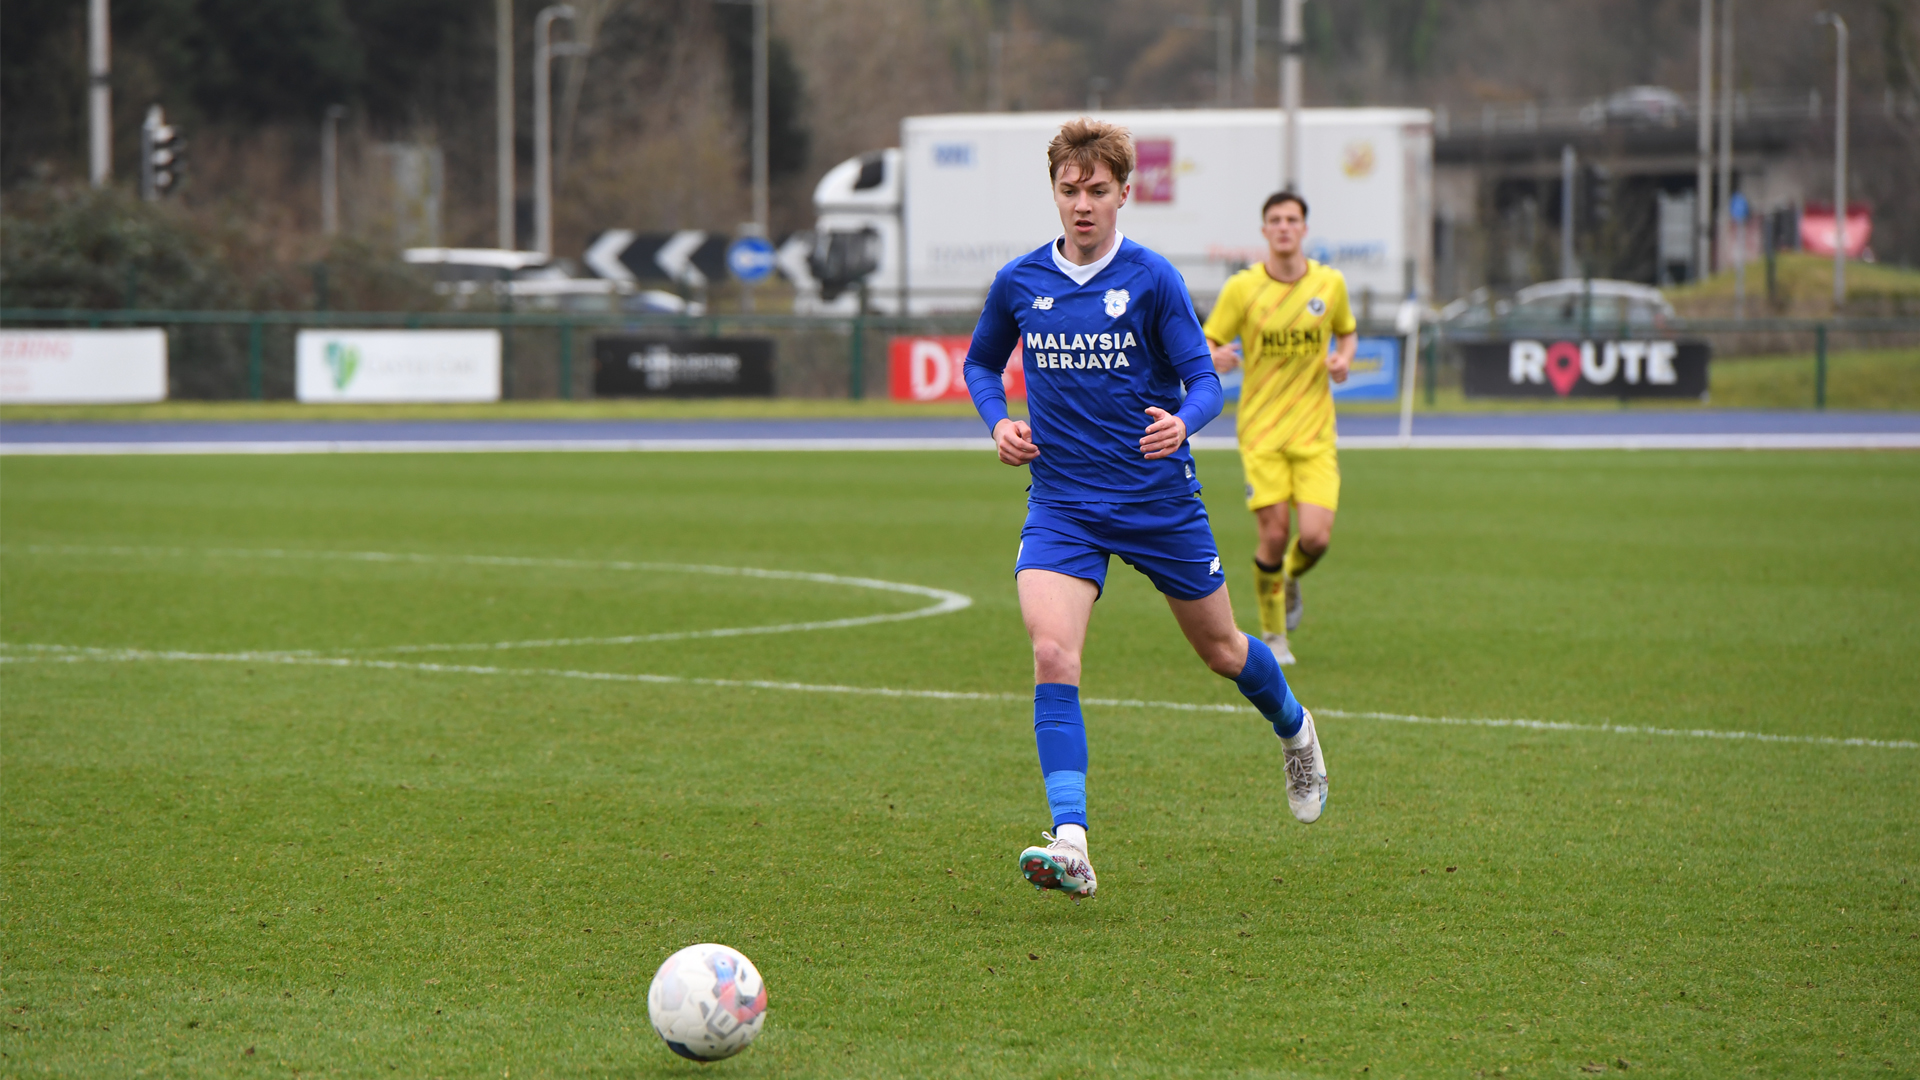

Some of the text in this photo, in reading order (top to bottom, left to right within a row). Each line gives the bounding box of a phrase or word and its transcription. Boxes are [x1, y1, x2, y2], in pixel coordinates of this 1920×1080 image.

[1027, 332, 1137, 350] MALAYSIA
[1262, 328, 1321, 347] HUSKI
[1035, 352, 1130, 369] BERJAYA
[1509, 340, 1678, 397] ROUTE
